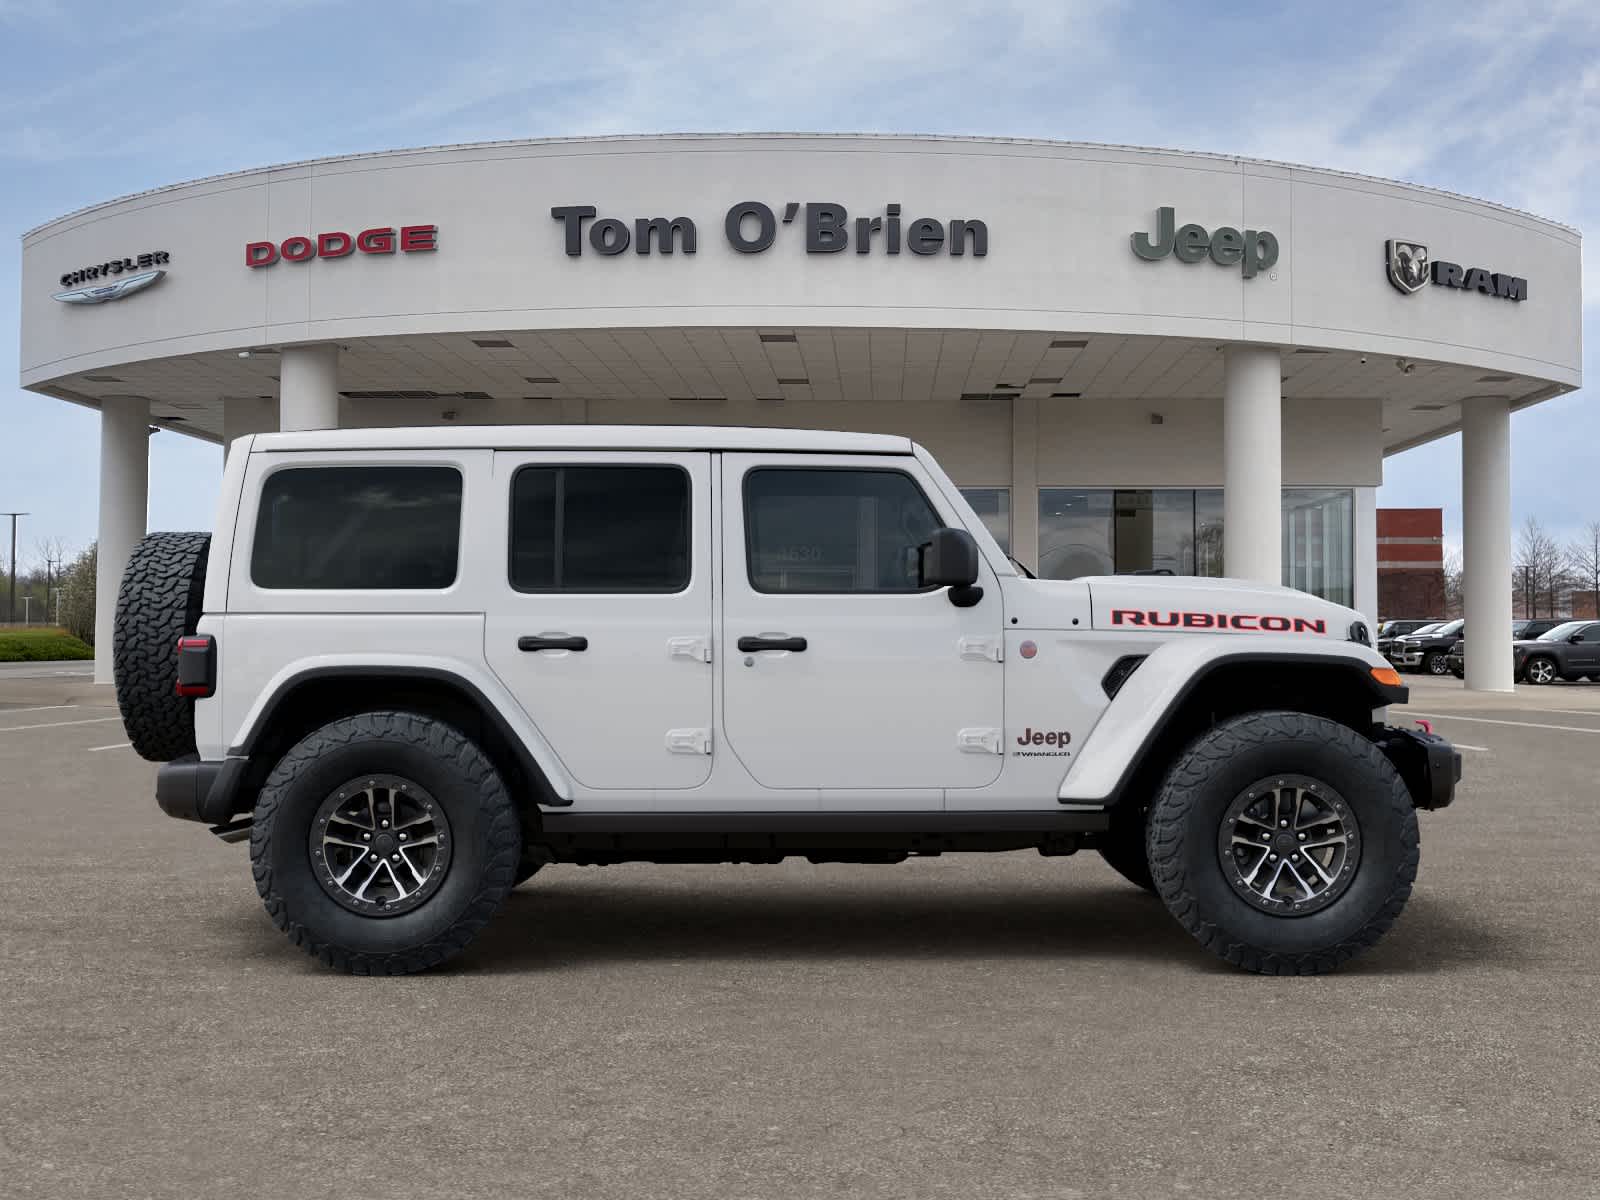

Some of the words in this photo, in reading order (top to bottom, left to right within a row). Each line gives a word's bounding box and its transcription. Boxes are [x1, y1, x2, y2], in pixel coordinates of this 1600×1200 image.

[246, 225, 438, 268] DODGE
[551, 205, 696, 256] Tom
[725, 201, 988, 256] O'Brien
[1131, 207, 1279, 279] Jeep
[61, 251, 170, 287] CHRYSLER
[1431, 260, 1528, 302] RAM
[1111, 609, 1327, 634] RUBICON
[1017, 728, 1071, 749] Jeep
